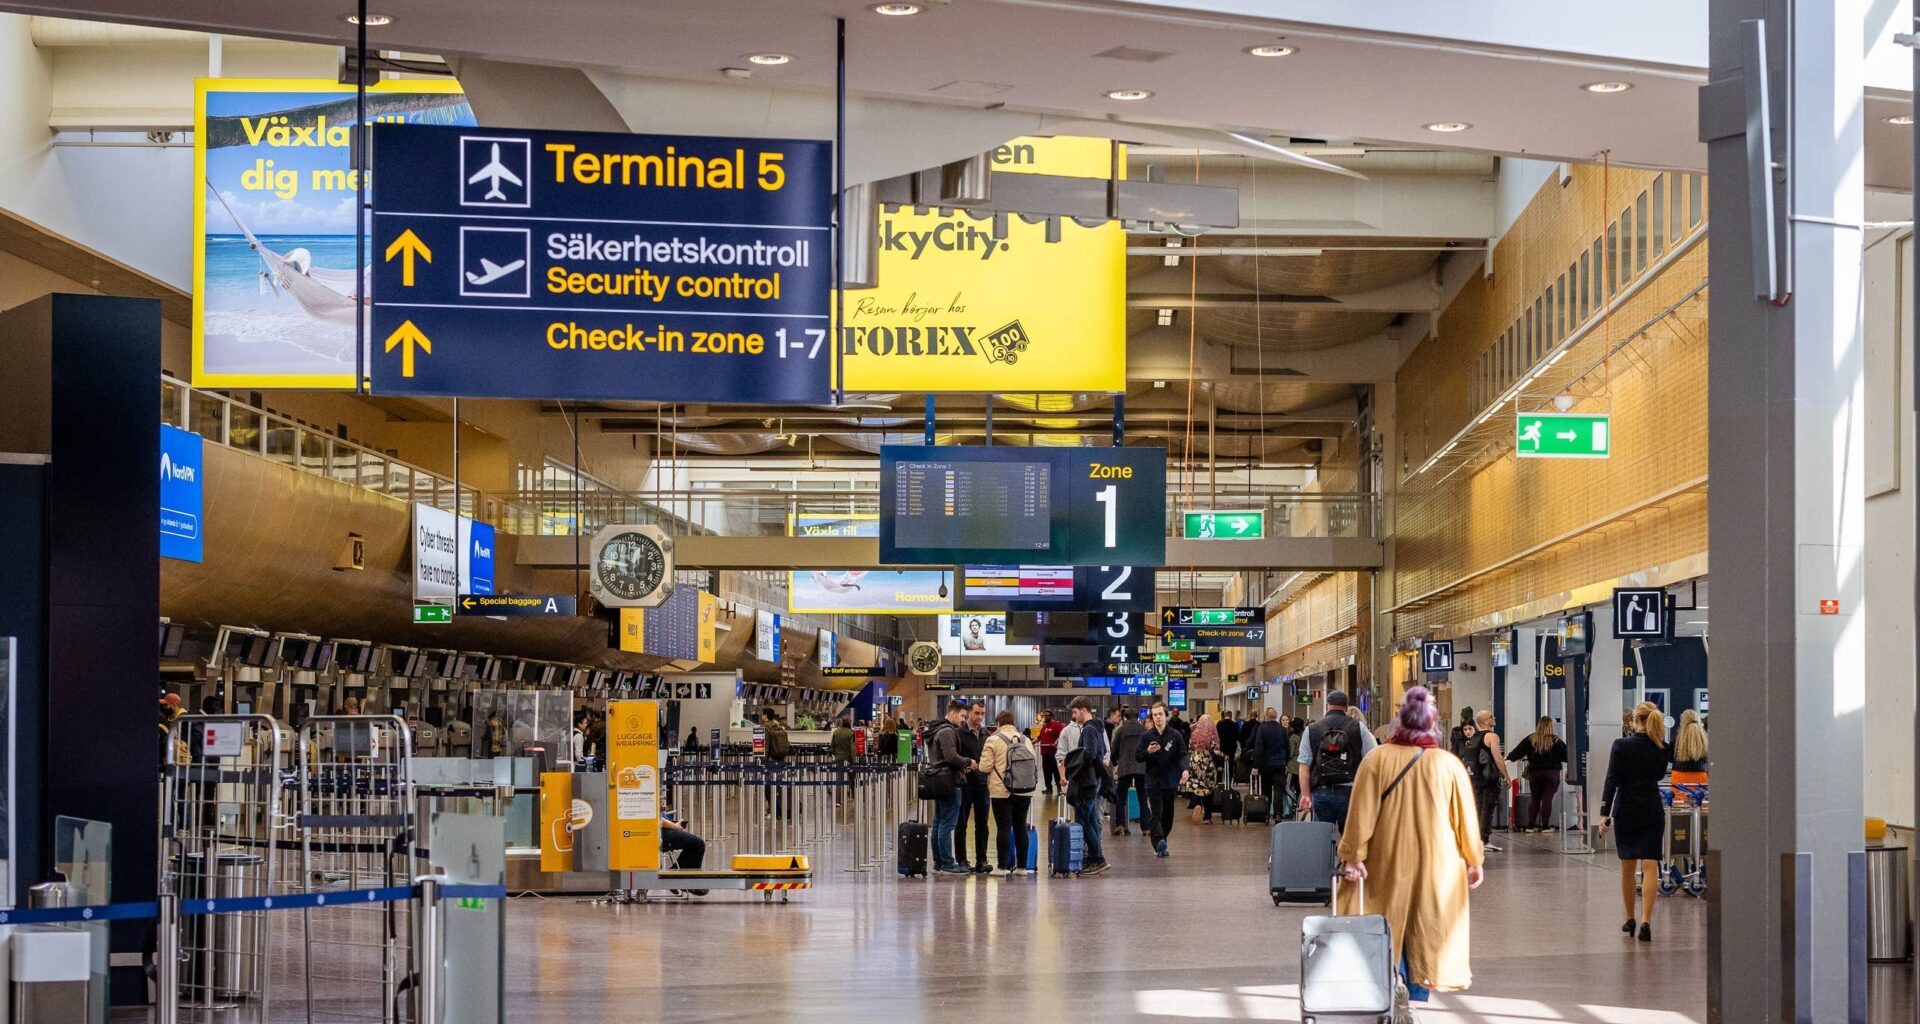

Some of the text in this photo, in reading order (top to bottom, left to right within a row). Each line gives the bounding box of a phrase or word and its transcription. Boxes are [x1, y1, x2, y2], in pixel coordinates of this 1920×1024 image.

[240, 115, 349, 147] Växla
[240, 158, 372, 200] dig me
[545, 143, 785, 191] Terminal 5
[547, 233, 809, 267] Säkerhetskontroll
[879, 220, 1009, 260] kyCity.
[547, 266, 780, 302] Security control
[853, 292, 967, 322] Resan börjar hos
[546, 321, 826, 359] Check-in zone 1-7
[842, 326, 978, 356] FOREX
[172, 462, 194, 482] NordVPN
[1090, 464, 1132, 478] Zone
[1096, 486, 1116, 547] 1
[420, 525, 454, 554] Cyber threats
[804, 526, 856, 537] Växla till
[420, 559, 432, 582] have
[433, 566, 440, 583] no
[610, 574, 616, 582] 8
[647, 574, 653, 582] 4
[1101, 566, 1132, 600] 2
[620, 581, 624, 589] 7
[628, 584, 634, 592] 6
[640, 581, 646, 589] 5
[480, 597, 558, 613] Special baggage A
[1106, 612, 1130, 638] 3
[1246, 630, 1264, 639] 4-7
[1110, 645, 1128, 662] 4
[1545, 664, 1566, 676] Sel
